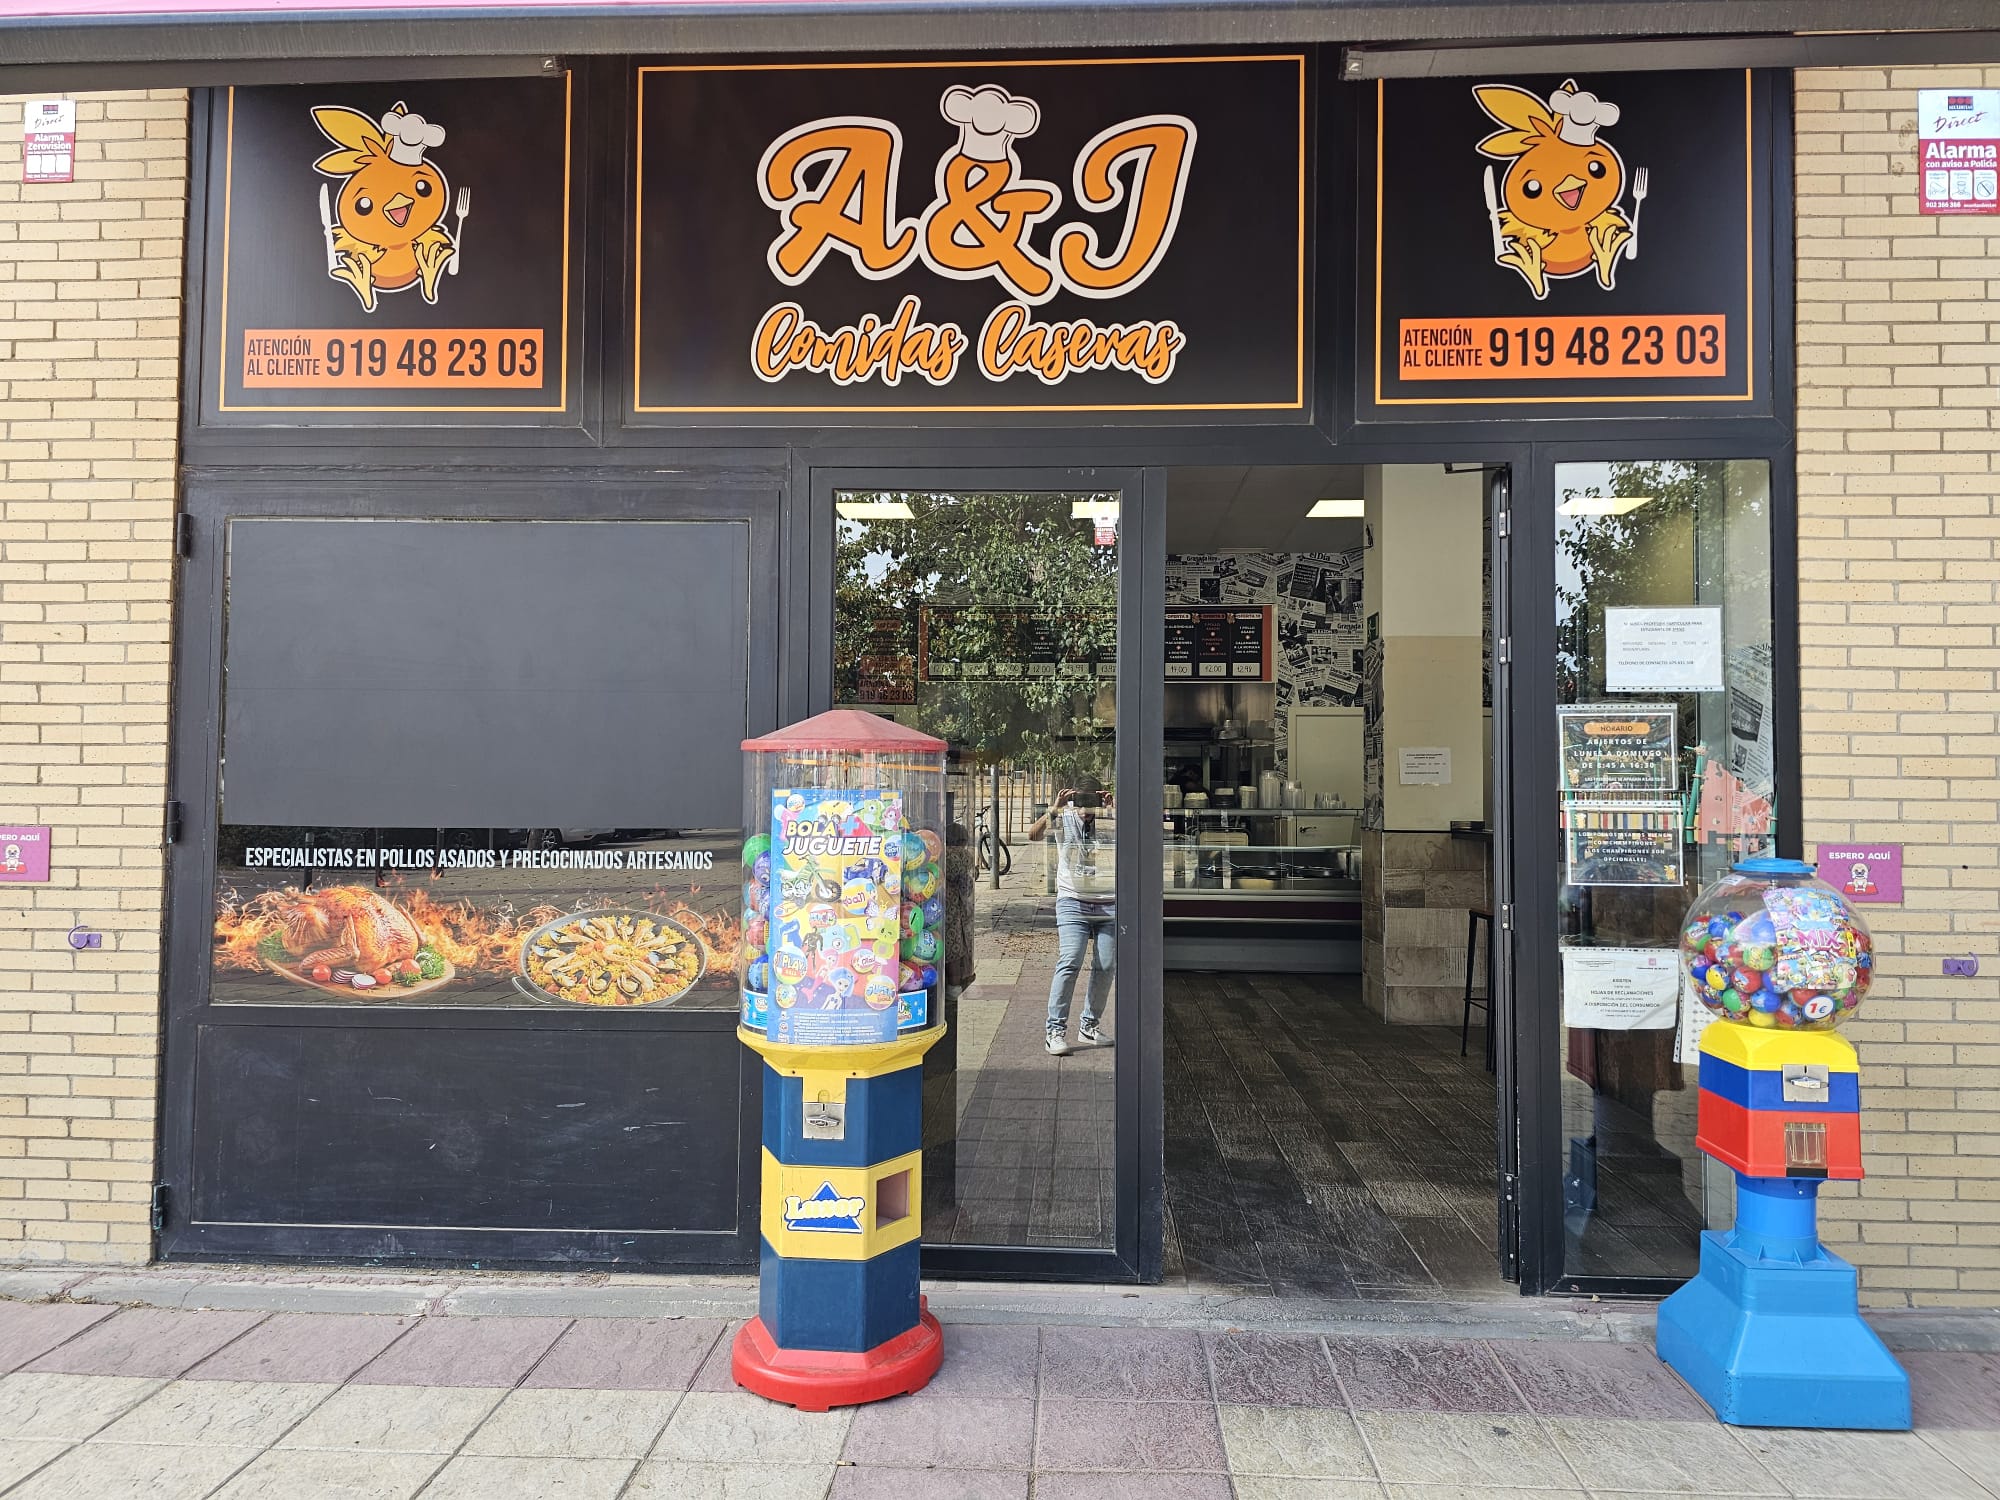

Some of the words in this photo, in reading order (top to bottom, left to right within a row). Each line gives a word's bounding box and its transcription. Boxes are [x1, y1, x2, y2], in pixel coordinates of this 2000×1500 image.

[1934, 111, 1988, 133] Direct
[34, 133, 65, 144] Alarma
[1925, 142, 1997, 159] Alarma
[1942, 160, 1962, 168] aviso
[757, 114, 1197, 305] A&J
[247, 334, 312, 356] ATENCIÓN
[750, 295, 968, 386] Comidas
[977, 300, 1186, 384] Caseras
[1404, 325, 1474, 348] ATENCIÓN
[1489, 327, 1555, 366] 919
[1566, 326, 1610, 366] 48
[1622, 326, 1664, 365] 23
[1676, 325, 1719, 364] 03
[247, 357, 264, 376] AL
[267, 356, 320, 376] CLIENTE
[326, 338, 387, 378] 919
[396, 338, 436, 377] 48
[448, 338, 487, 376] 23
[498, 338, 538, 376] 03
[1404, 349, 1422, 368] AL
[1425, 348, 1483, 367] CLIENTE
[20, 832, 40, 841] AQUÍ
[786, 820, 838, 837] BOLA
[783, 836, 882, 856] JUGUETE
[1828, 852, 1864, 860] ESPERO
[1868, 850, 1891, 860] AQUÍ
[245, 848, 352, 868] ESPECIALISTAS
[356, 848, 376, 868] EN
[380, 848, 434, 868] POLLOS
[438, 848, 496, 869] ASADOS
[500, 849, 508, 869] Y
[512, 849, 623, 870] PRECOCINADOS
[627, 850, 713, 871] ARTESANOS
[1795, 930, 1842, 948] MIX
